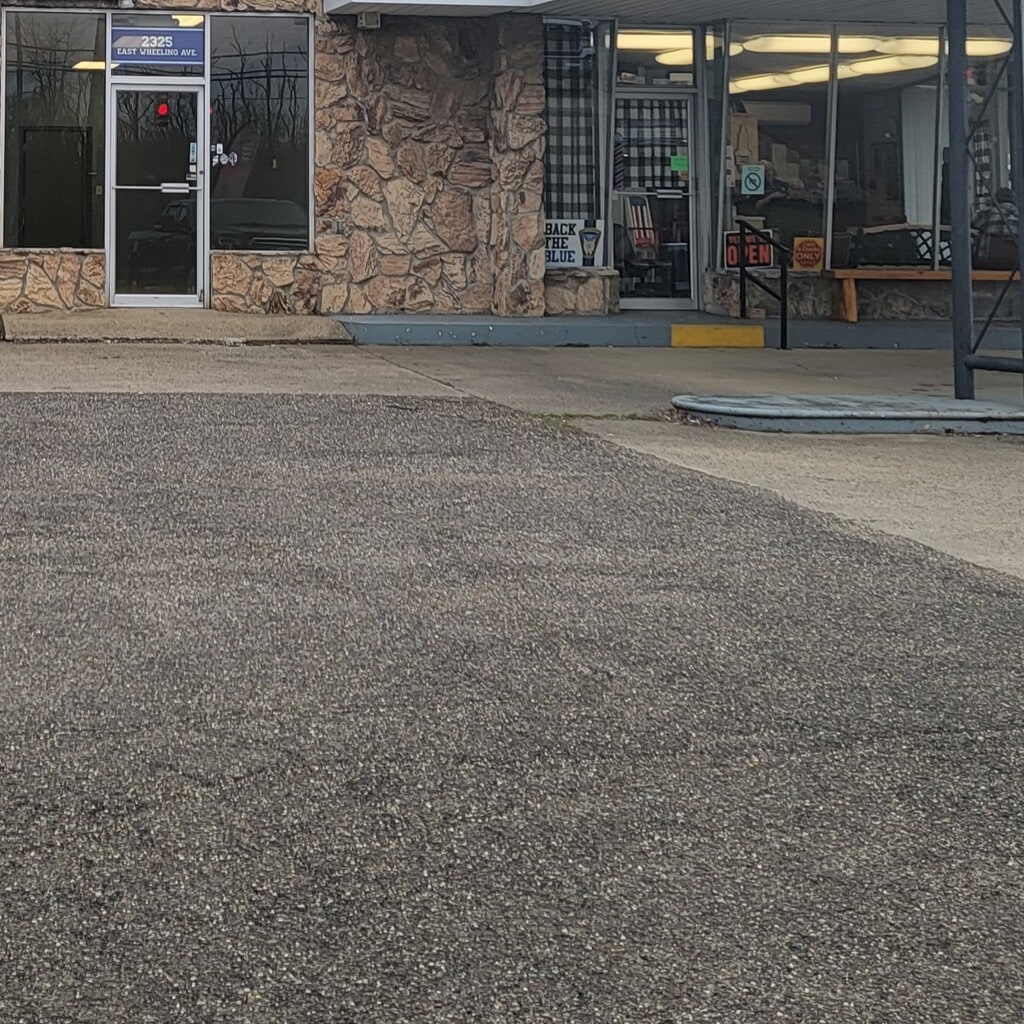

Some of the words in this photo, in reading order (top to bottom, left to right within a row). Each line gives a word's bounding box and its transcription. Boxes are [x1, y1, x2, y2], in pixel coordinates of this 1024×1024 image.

[141, 36, 173, 48] 2325
[544, 223, 577, 236] BACK
[545, 237, 569, 249] THE
[545, 250, 576, 263] BLUE
[727, 244, 770, 265] OEN
[796, 252, 821, 261] ONLY
